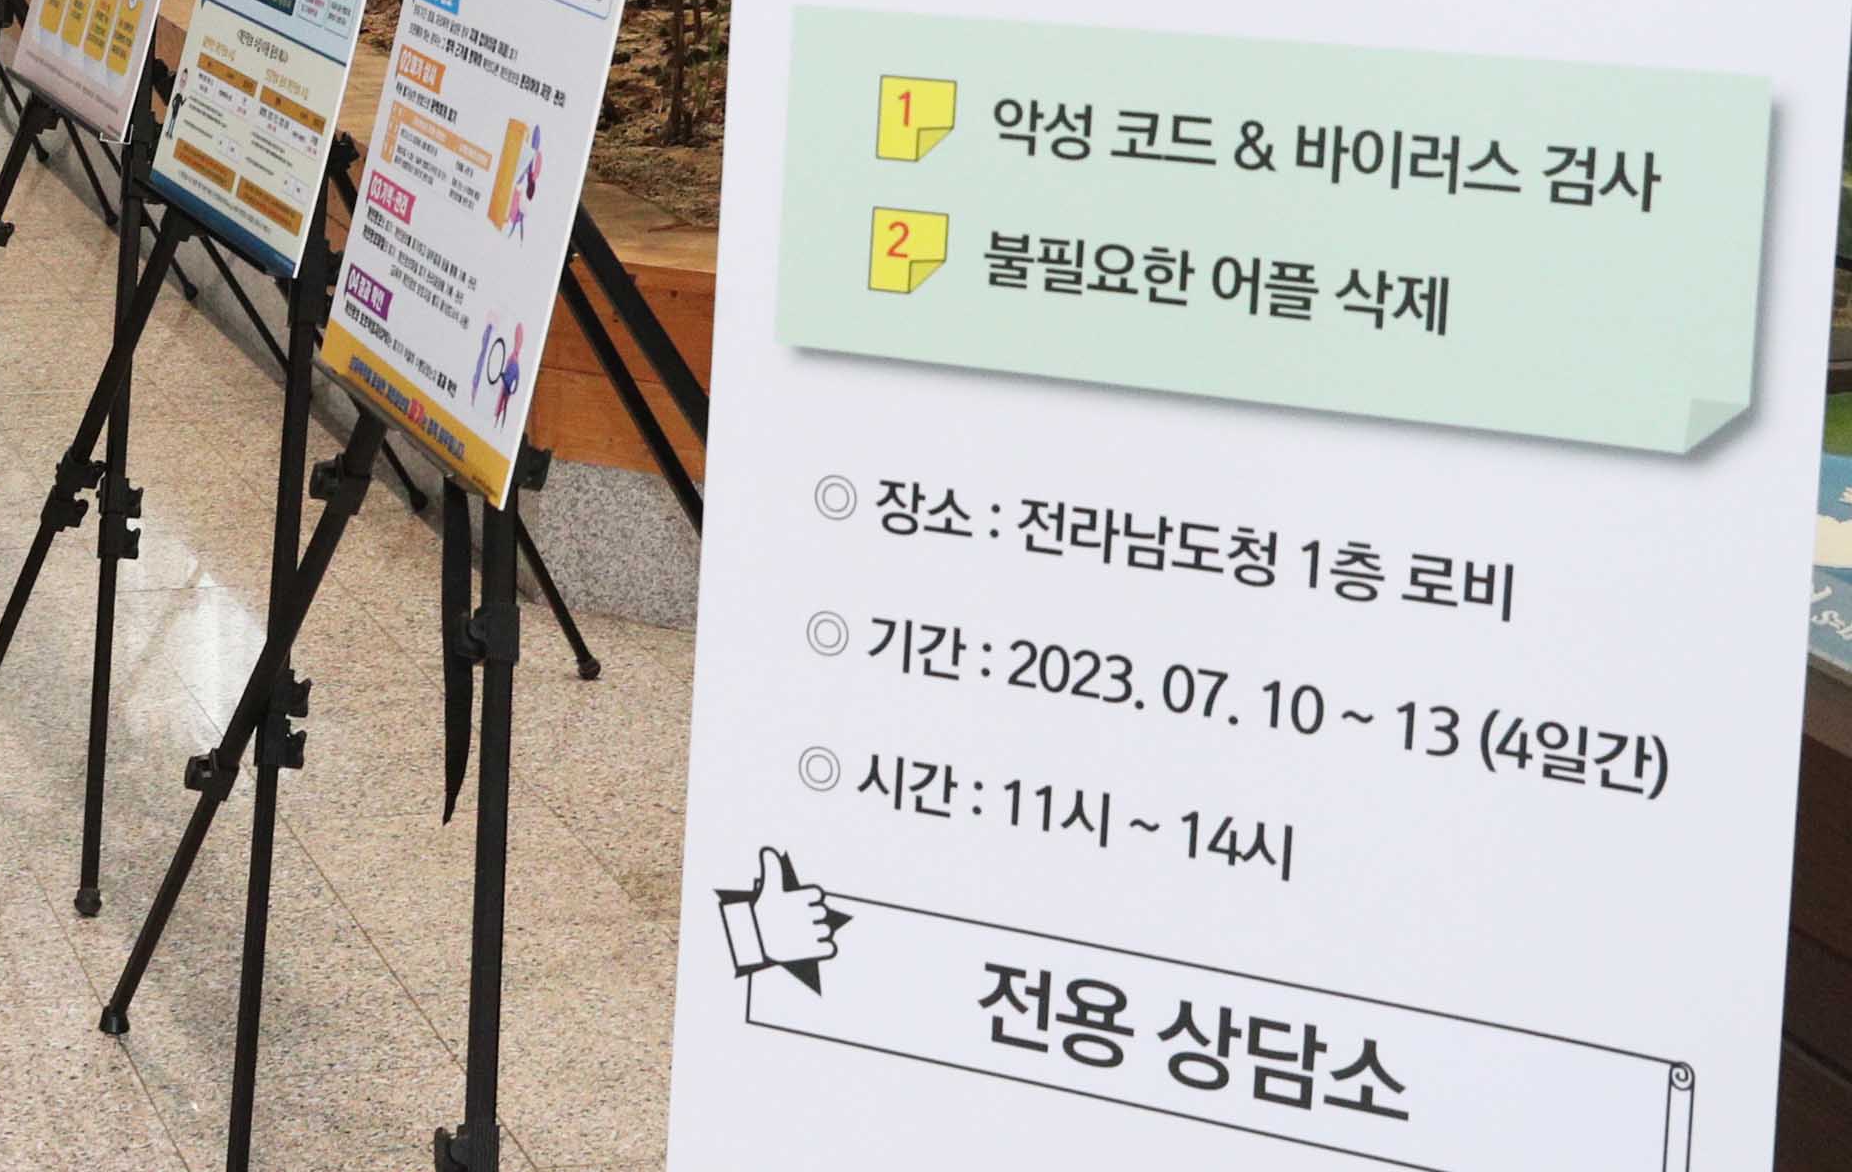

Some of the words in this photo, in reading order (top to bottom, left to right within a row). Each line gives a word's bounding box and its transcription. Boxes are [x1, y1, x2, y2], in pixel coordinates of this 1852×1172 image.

[896, 91, 912, 127] 1
[994, 99, 1092, 160] 악성
[1111, 111, 1216, 165] 코드
[1234, 120, 1275, 171] &
[1296, 126, 1521, 194] 바이러스
[1543, 146, 1661, 212] 검사
[886, 223, 909, 259] 2
[984, 231, 1195, 306] 불필요한
[1212, 256, 1319, 320] 어플
[1335, 269, 1449, 336] 삭제
[876, 480, 972, 537] 장소
[1018, 499, 1277, 587] 전라남도청
[1302, 540, 1385, 602] 1층
[1402, 554, 1513, 622] 로비
[868, 618, 967, 680] 기간
[1008, 640, 1144, 710] 2023.
[1163, 664, 1238, 725] 07.
[1263, 681, 1324, 735] 10
[1397, 702, 1459, 756] 13
[1480, 709, 1668, 800] (4일간)
[858, 754, 958, 818] 시간
[1004, 780, 1110, 848] 11시
[1182, 811, 1292, 881] 14시
[977, 959, 1133, 1069] 전용
[1156, 996, 1410, 1120] 상담소
